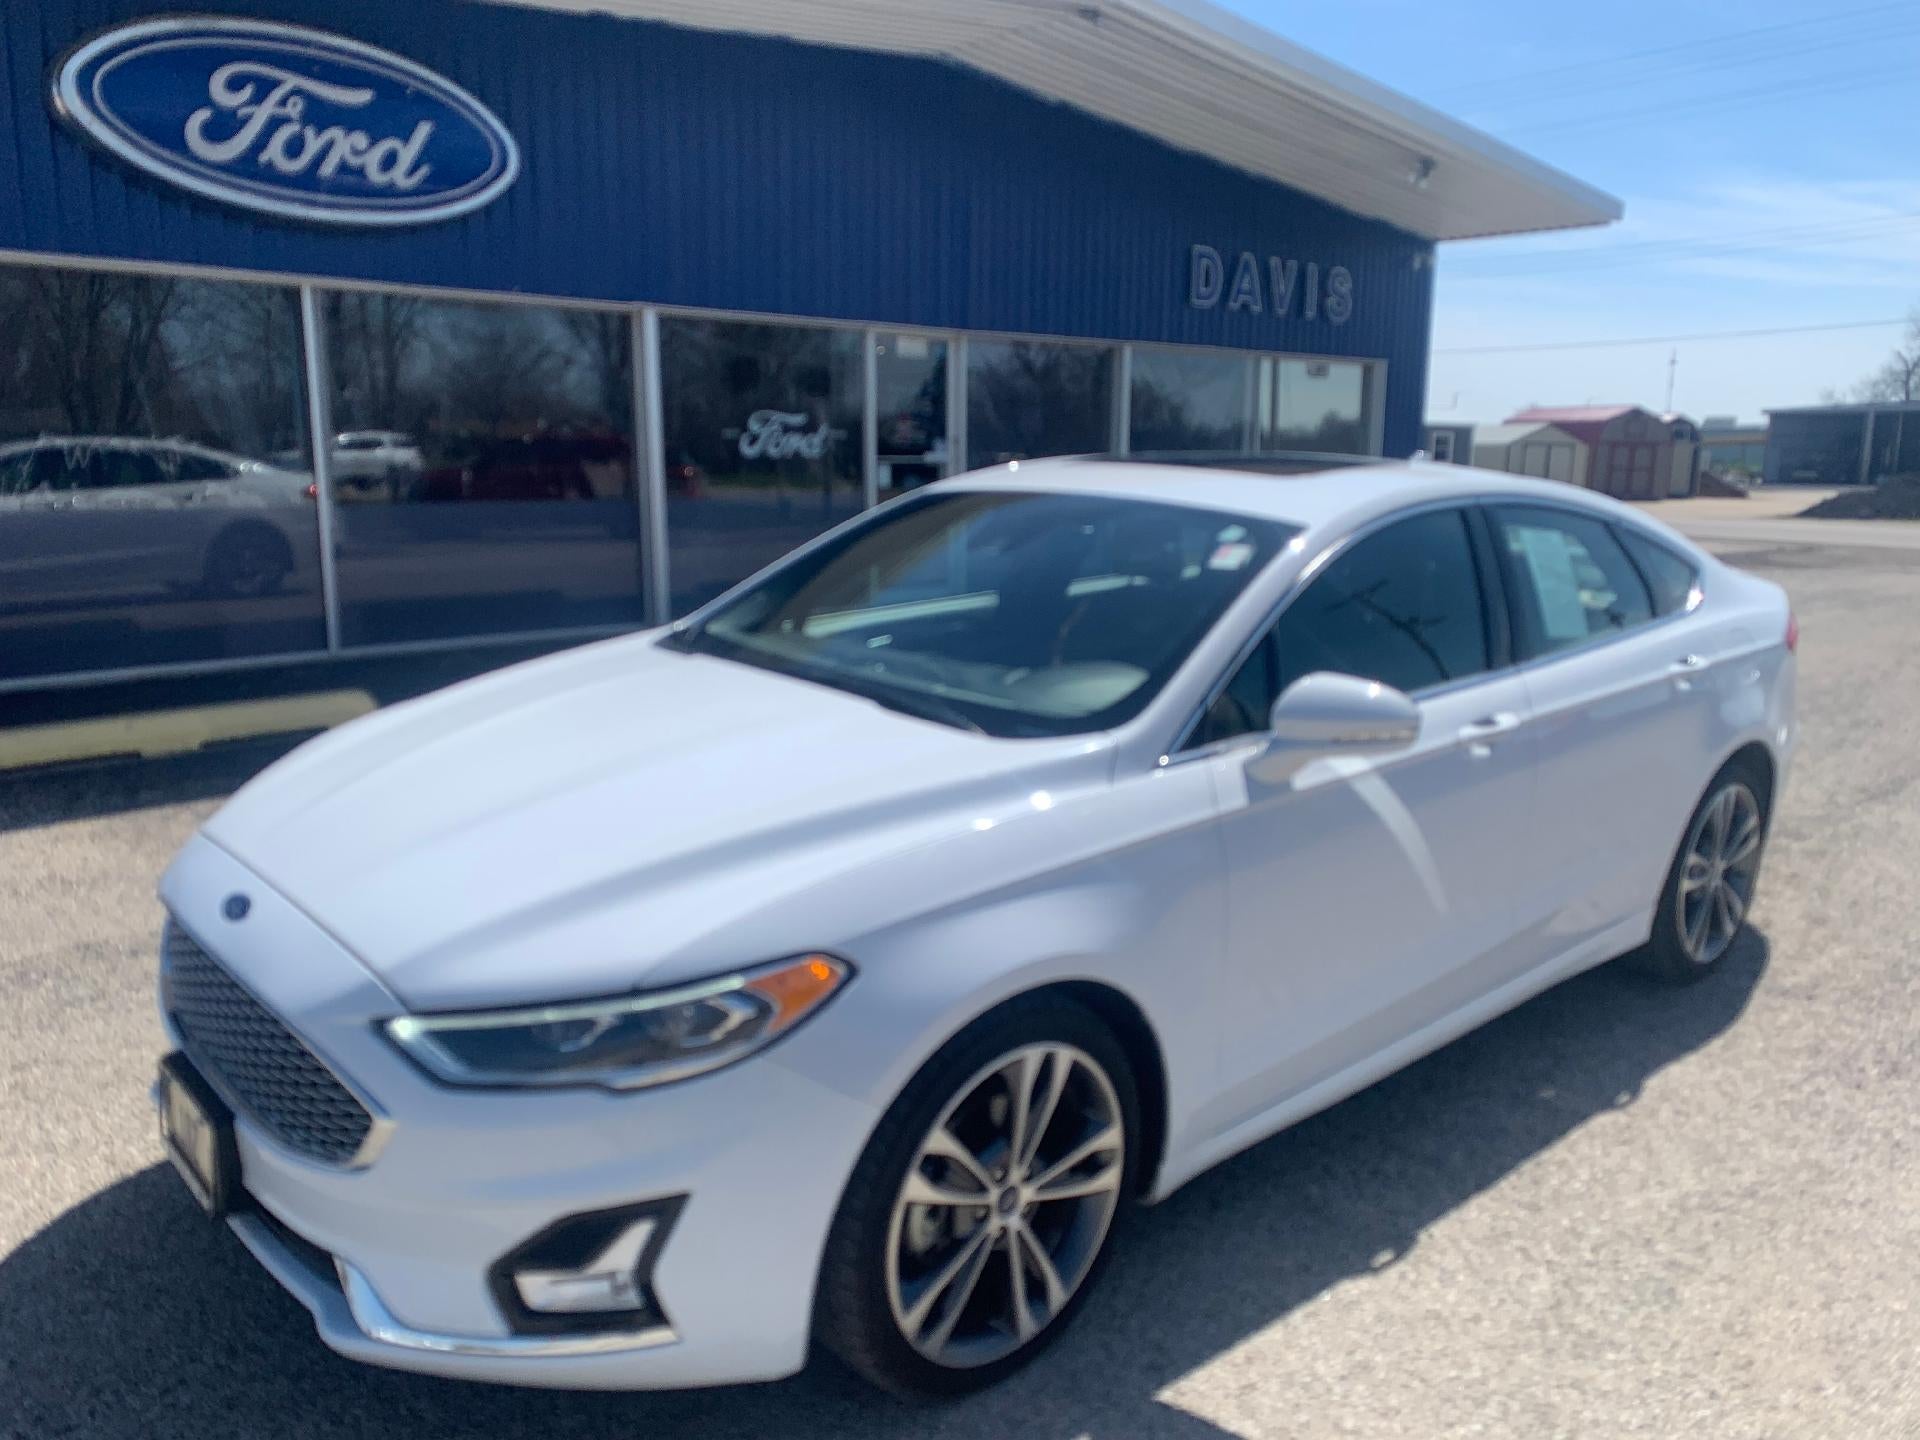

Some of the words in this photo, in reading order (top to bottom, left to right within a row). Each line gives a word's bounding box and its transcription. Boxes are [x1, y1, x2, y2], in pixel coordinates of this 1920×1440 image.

[184, 61, 435, 190] Ford
[1190, 244, 1353, 325] DAVIS
[739, 409, 829, 459] Ford
